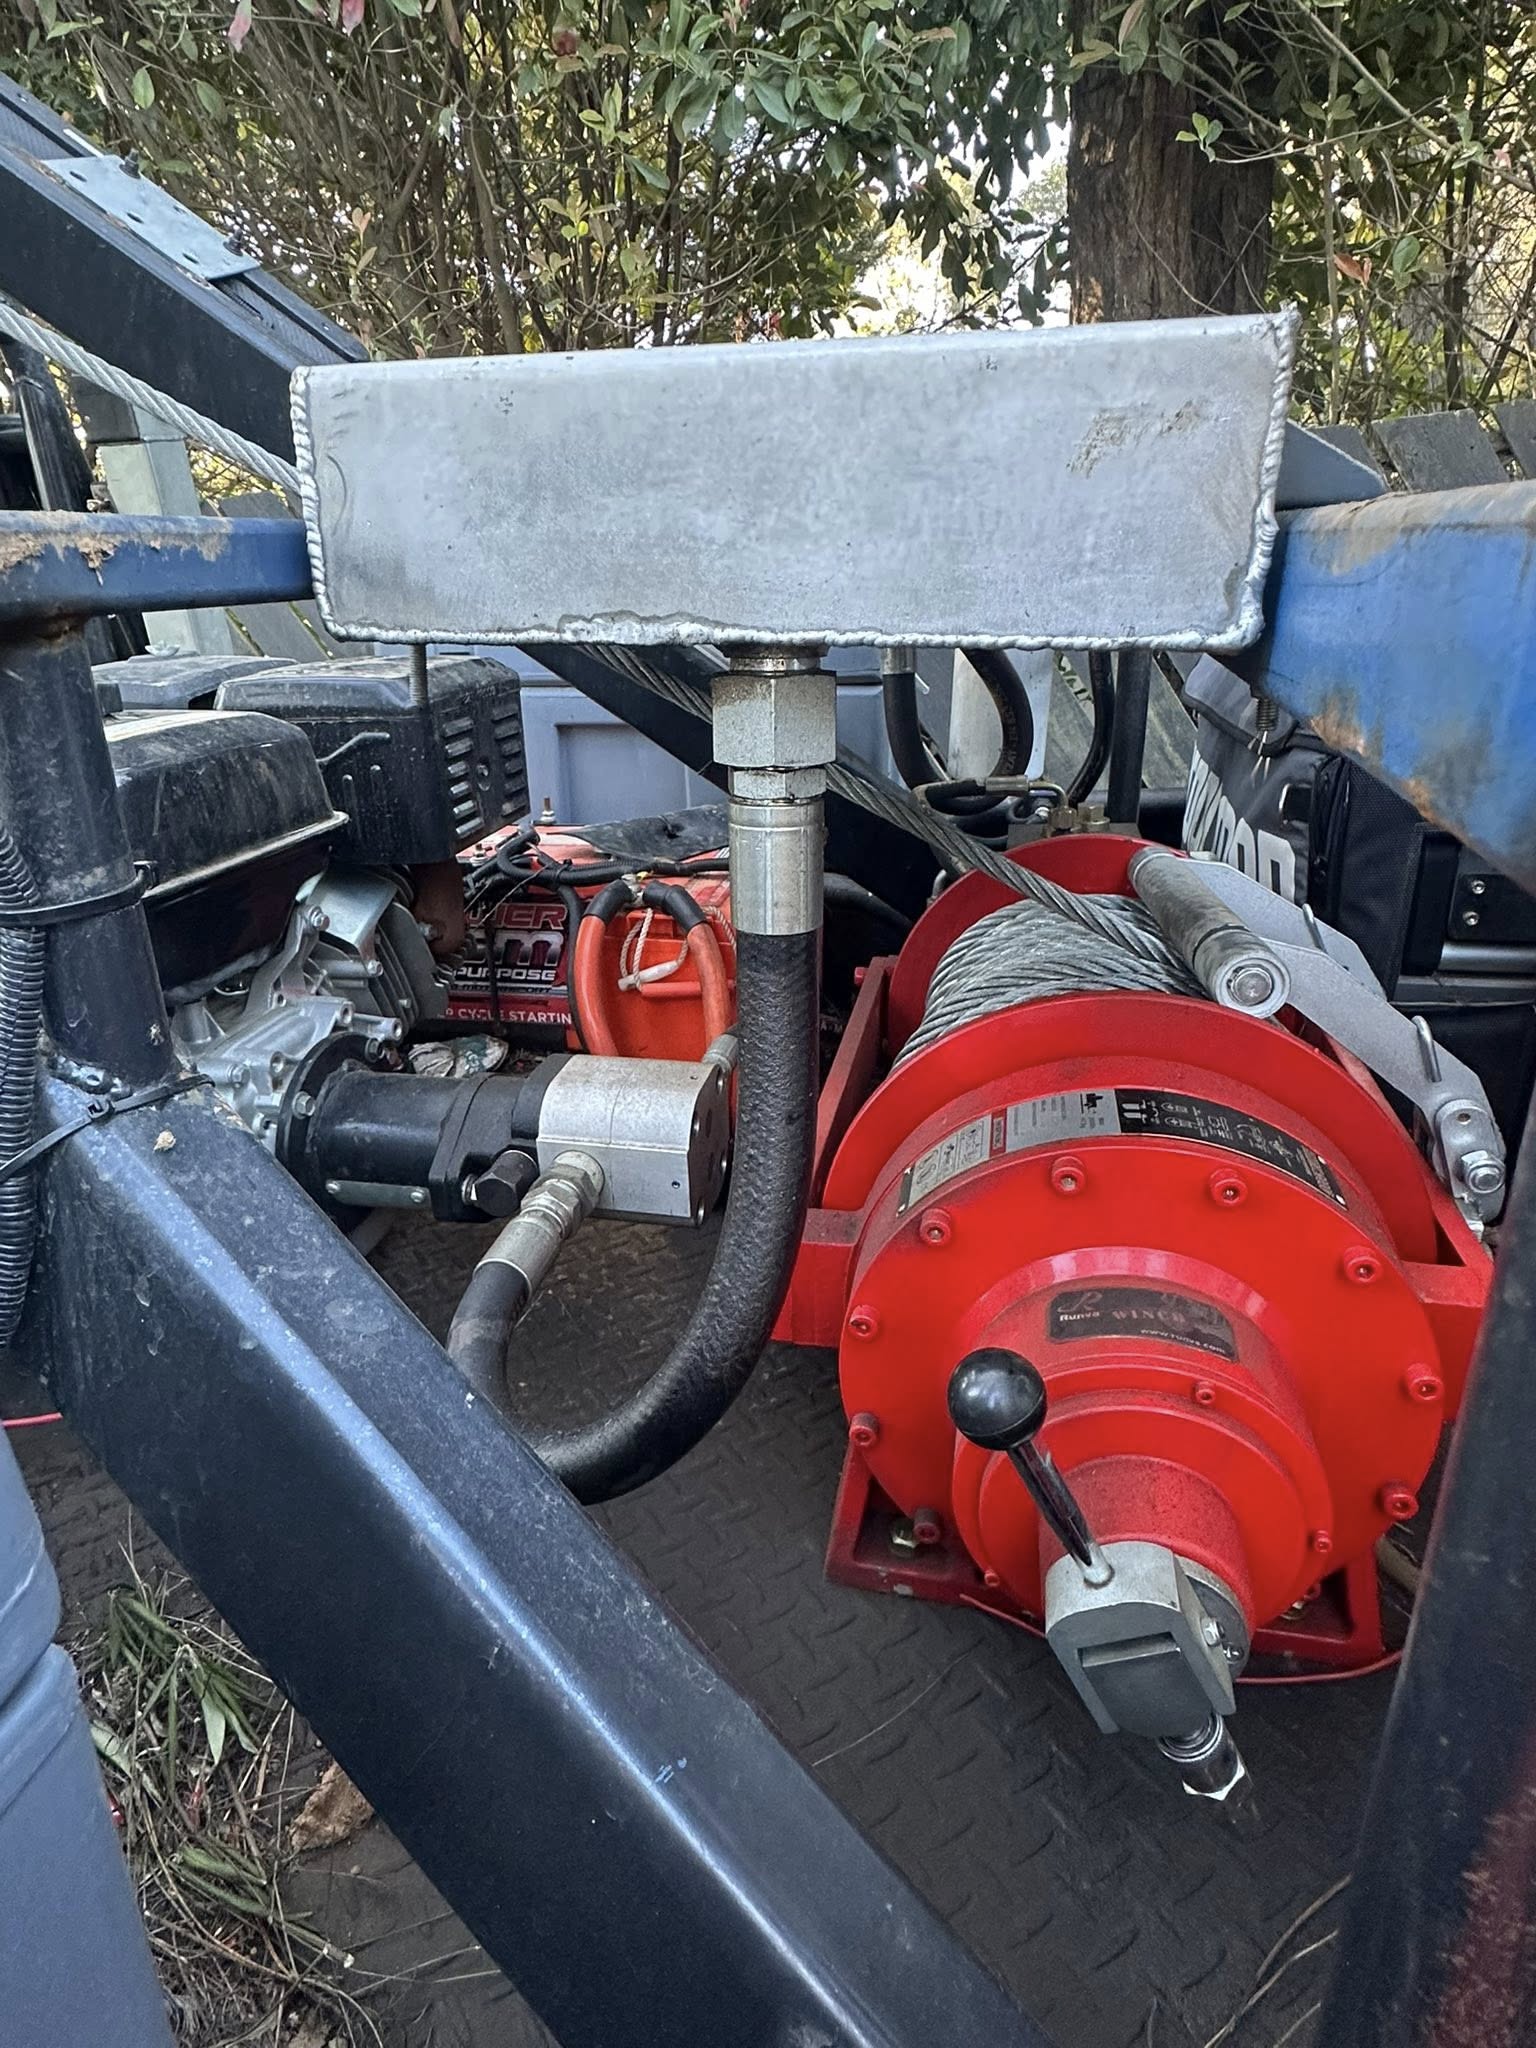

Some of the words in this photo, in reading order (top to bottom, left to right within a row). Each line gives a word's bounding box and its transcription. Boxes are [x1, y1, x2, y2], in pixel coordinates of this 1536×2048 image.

[509, 1010, 572, 1025] STARTIN
[1059, 1311, 1100, 1322] Runva
[1112, 1309, 1186, 1324] WINCH
[1139, 1329, 1227, 1354] www.runva.com
